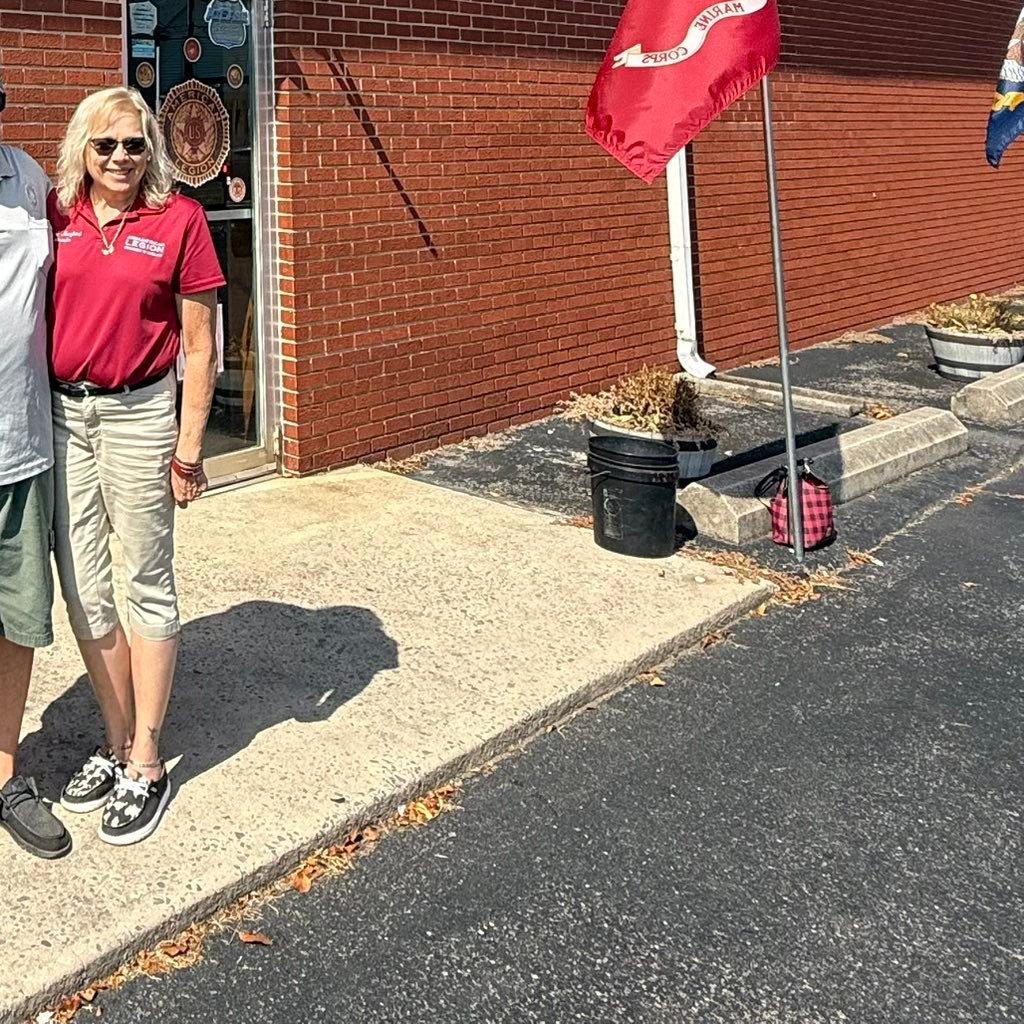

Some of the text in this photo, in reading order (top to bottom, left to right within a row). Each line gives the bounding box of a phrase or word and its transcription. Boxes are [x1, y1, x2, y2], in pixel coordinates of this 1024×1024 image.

[167, 90, 221, 123] AMERICAN
[189, 124, 201, 140] US
[175, 156, 215, 176] LEGION
[125, 238, 165, 254] LEGION
